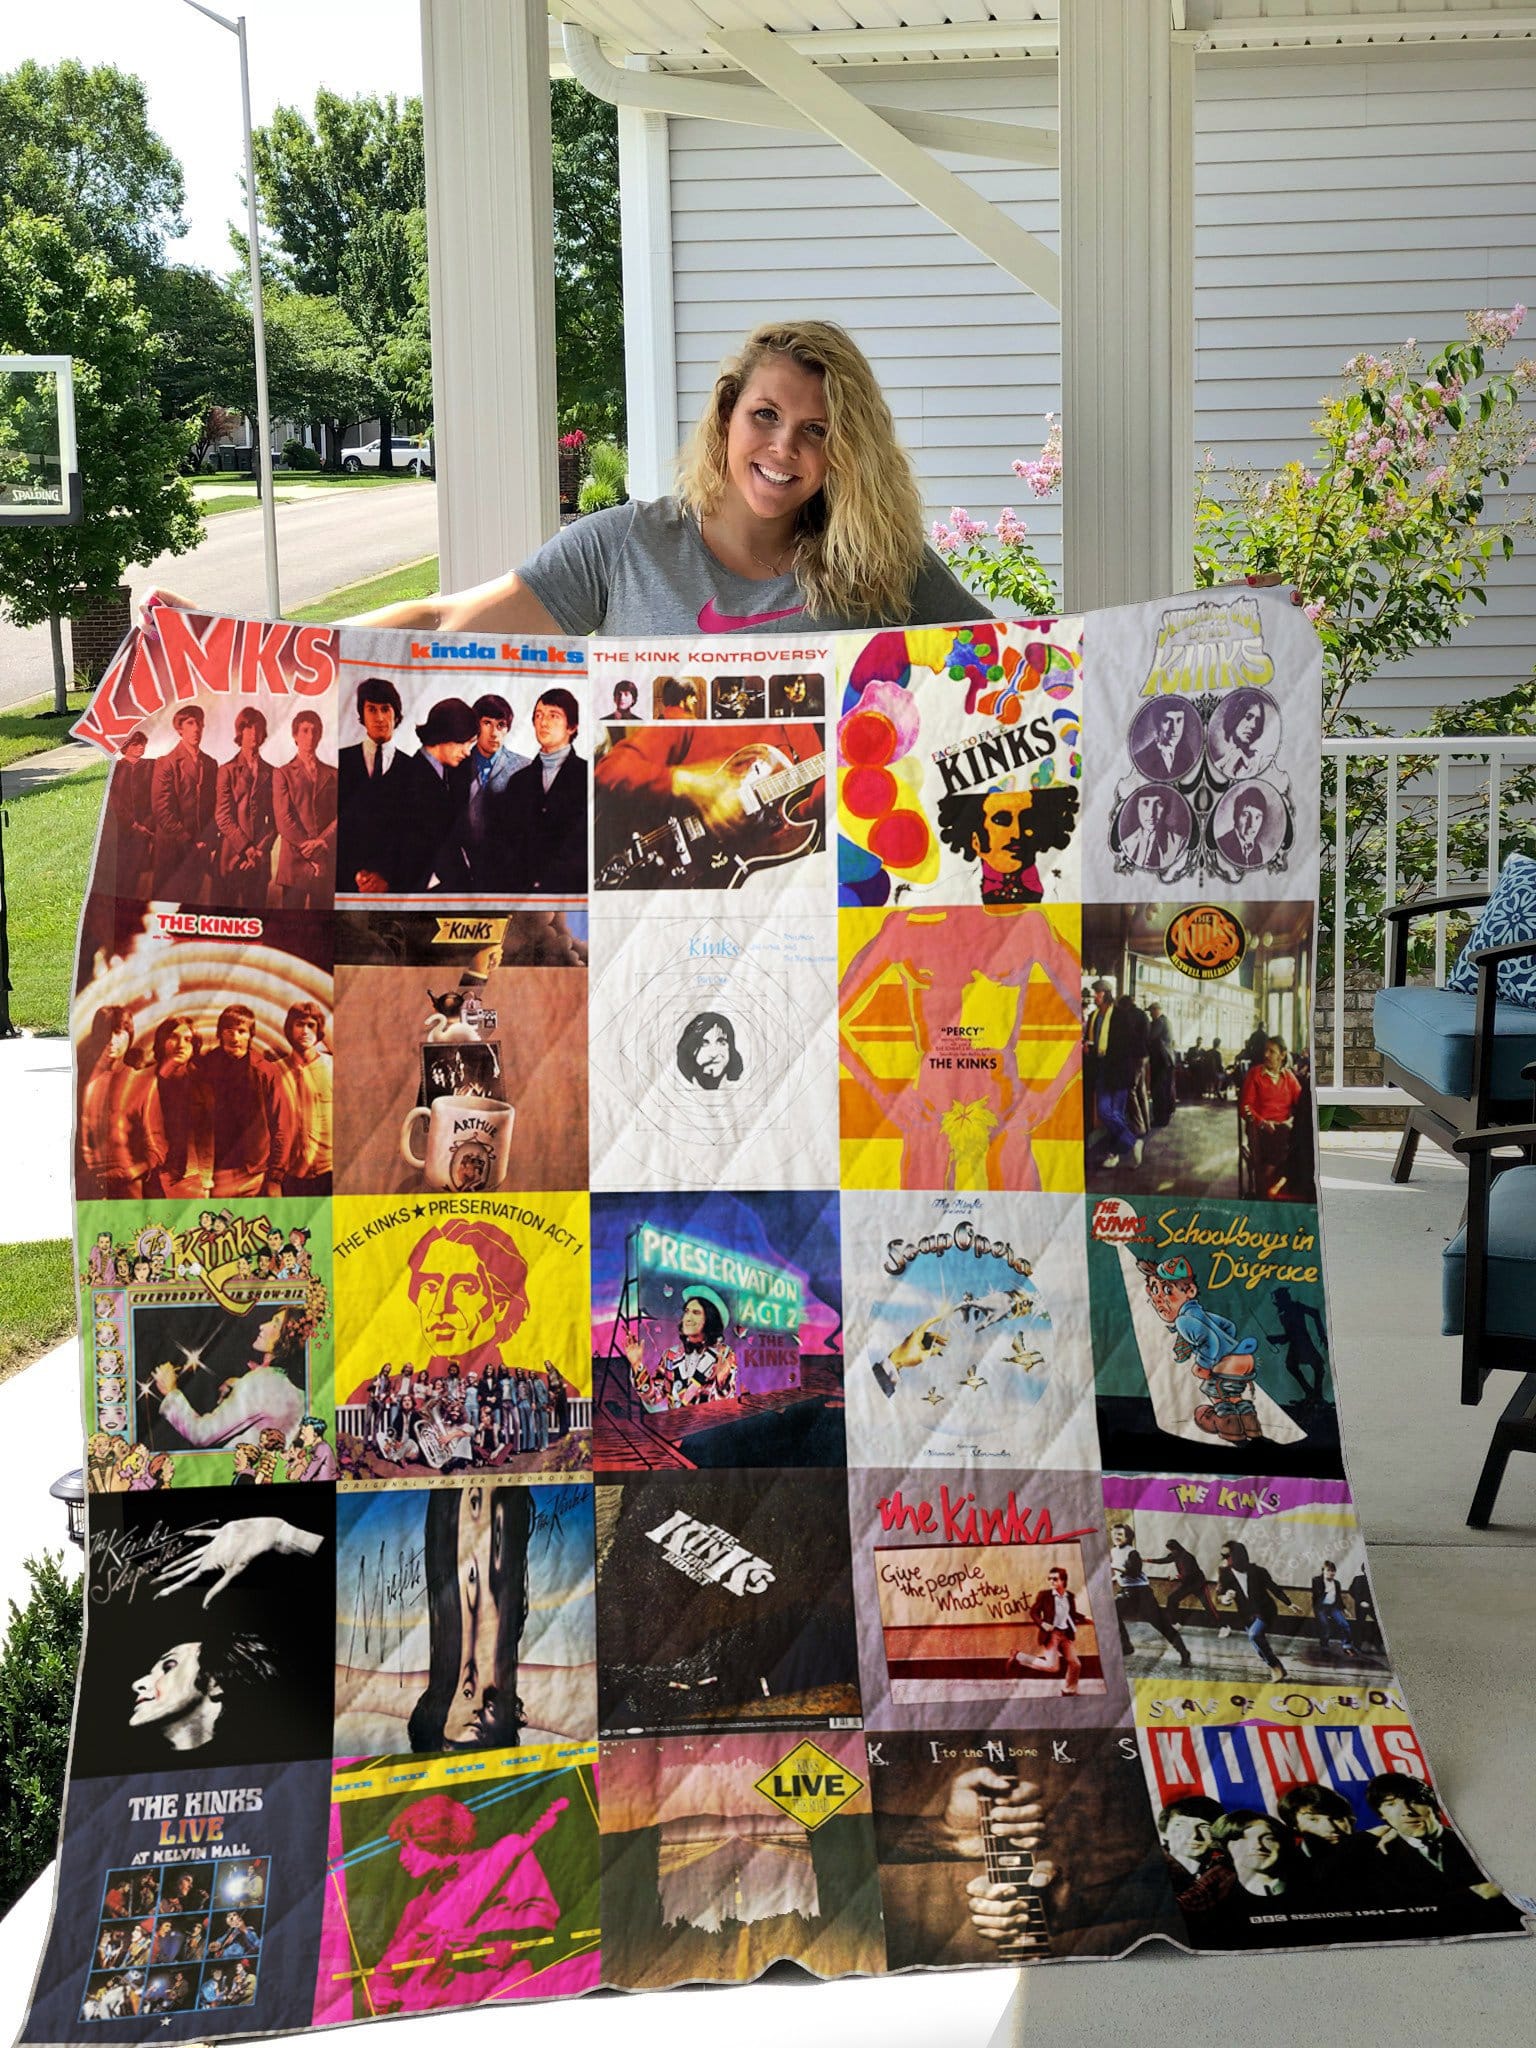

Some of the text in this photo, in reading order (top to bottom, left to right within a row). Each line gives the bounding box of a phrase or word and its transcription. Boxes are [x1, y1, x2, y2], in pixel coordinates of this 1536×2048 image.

[12, 489, 61, 502] SPALDING
[411, 642, 585, 664] kinda kinks
[593, 649, 829, 663] THE KINK KONTROVERSY
[1139, 637, 1275, 697] KINKS
[71, 606, 338, 755] KINKS
[935, 716, 1056, 795] KINKS
[157, 914, 260, 935] THE KINKS
[448, 921, 493, 939] KINKS
[688, 935, 740, 957] Kinks
[929, 1058, 997, 1069] THE KINKS
[453, 1118, 498, 1138] ARTHUR
[1093, 1201, 1121, 1216] THE
[333, 1199, 584, 1259] THE KINKS PRESERVATION ACT 1
[1092, 1216, 1148, 1234] KINKS
[1157, 1208, 1315, 1260] Schoolboys in
[173, 1216, 272, 1306] Kinks
[884, 1221, 1033, 1277] Soap Opera
[643, 1229, 797, 1301] PRESERVATION
[1208, 1250, 1319, 1290] Disgrace
[133, 1289, 212, 1303] EVERYBODY'S
[231, 1290, 244, 1300] IN
[741, 1299, 798, 1328] ACT 2
[758, 1334, 785, 1347] THE
[744, 1347, 799, 1368] KINKS
[342, 1474, 586, 1490] ORIGINAL MASTER RECORDING
[1168, 1484, 1281, 1515] THE KINKS
[97, 1519, 212, 1573] Kinks
[706, 1524, 740, 1549] THE
[645, 1509, 776, 1597] KINKS
[680, 1551, 709, 1569] LOW
[662, 1551, 714, 1587] BUDGET
[881, 1565, 921, 1587] Give
[900, 1563, 985, 1602] the people
[936, 1581, 1010, 1612] What they
[987, 1592, 1033, 1619] Want
[1149, 1690, 1406, 1720] STATE OF CONFUSION
[943, 1747, 1038, 1758] to the bone
[1155, 1730, 1426, 1785] KINKS
[774, 1774, 845, 1797] LIVE
[128, 1787, 263, 1821] THE KINKS
[158, 1816, 225, 1845] LIVE
[131, 1851, 150, 1865] AT
[1291, 1910, 1353, 1920] SESSIONS
